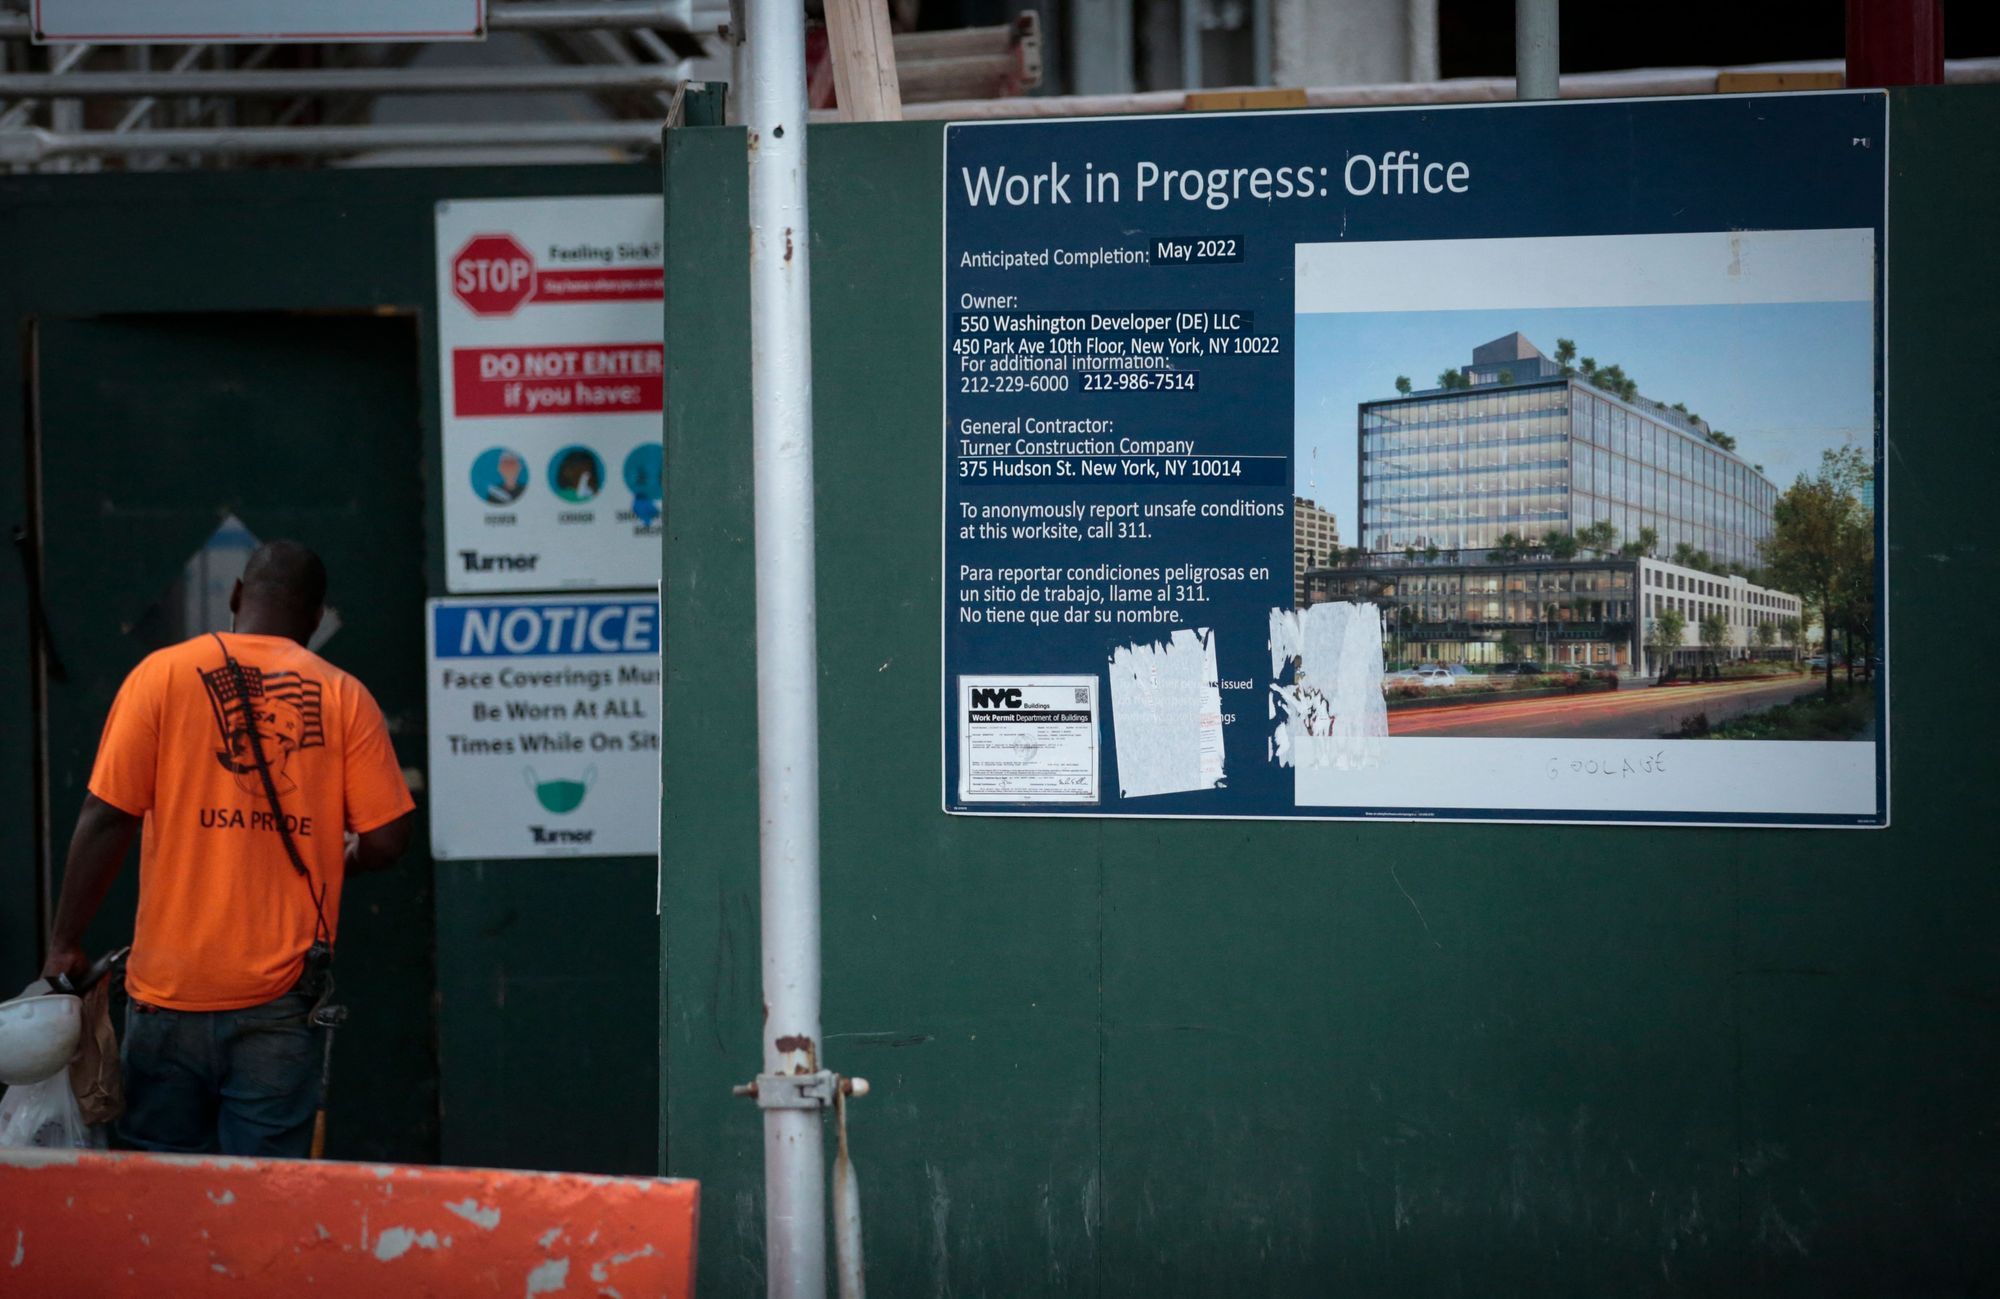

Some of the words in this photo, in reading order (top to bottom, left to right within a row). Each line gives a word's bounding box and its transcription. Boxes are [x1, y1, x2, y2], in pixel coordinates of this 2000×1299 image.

[962, 162, 1071, 206] Work
[1087, 163, 1119, 202] in
[1138, 162, 1327, 210] Progress:
[1345, 151, 1469, 195] Office
[549, 244, 614, 264] Feeling
[961, 249, 1048, 270] Anticipated
[1054, 248, 1148, 268] Completion:
[1159, 243, 1192, 261] May
[1198, 240, 1235, 256] 2022
[456, 258, 530, 293] STOP
[961, 293, 1017, 309] Owner:
[961, 316, 989, 332] 550
[993, 315, 1085, 334] Washington
[1092, 313, 1171, 333] Developer
[1177, 313, 1208, 333] (DE)
[1214, 314, 1240, 329] LLC
[953, 339, 979, 357] 450
[983, 338, 1015, 355] Park
[1016, 339, 1044, 356] Ave
[1050, 337, 1081, 356] 10th
[1087, 338, 1127, 357] Floor,
[1132, 338, 1164, 353] New
[1167, 337, 1203, 358] York,
[1210, 338, 1229, 353] NY
[1235, 337, 1278, 353] 10022
[480, 353, 520, 377] DO
[524, 352, 578, 376] NOT
[582, 351, 662, 375] ENTER
[962, 356, 985, 371] For
[991, 355, 1066, 371] additional
[1073, 354, 1170, 369] information:
[962, 376, 1068, 392] 212-229-6000
[1085, 374, 1194, 390] 212-986-7514
[504, 383, 522, 407] if
[526, 386, 572, 411] you
[576, 381, 641, 404] have:
[961, 417, 1020, 434] General
[1026, 418, 1112, 433] Contractor:
[960, 440, 1011, 456] Turner
[1015, 439, 1115, 455] Construction
[1120, 439, 1195, 456] Company
[960, 461, 987, 476] 375
[994, 460, 1051, 476] Hudson
[1057, 460, 1075, 475] St.
[1082, 460, 1116, 475] New
[1122, 459, 1159, 478] York,
[1166, 460, 1186, 475] NY
[1193, 460, 1241, 476] 10014
[960, 503, 977, 518] To
[982, 501, 1085, 523] anonymously
[1090, 503, 1140, 521] report
[1145, 500, 1195, 516] unsafe
[1201, 500, 1284, 516] conditions
[960, 525, 975, 538] at
[980, 522, 1007, 538] this
[1012, 522, 1082, 541] worksite,
[1088, 522, 1112, 538] call
[1119, 522, 1151, 538] 311.
[459, 551, 539, 572] Turner
[961, 565, 992, 580] Para
[999, 566, 1062, 586] reportar
[1067, 564, 1159, 580] condiciones
[1166, 564, 1244, 586] peligrosas
[1250, 568, 1268, 579] en
[961, 590, 978, 601] un
[984, 586, 1015, 601] sitio
[1021, 585, 1039, 601] de
[1045, 585, 1104, 605] trabajo,
[1110, 585, 1152, 601] llame
[1158, 585, 1170, 601] al
[1176, 586, 1209, 601] 311.
[961, 607, 981, 622] No
[986, 607, 1025, 622] tiene
[1031, 611, 1059, 626] que
[1064, 606, 1090, 622] dar
[1095, 611, 1111, 622] su
[1118, 606, 1183, 622] nombre.
[460, 606, 655, 655] NOTICE
[442, 668, 493, 689] Face
[500, 665, 613, 691] Coverings
[1221, 678, 1253, 689] issued
[972, 688, 1022, 709] NYC
[473, 702, 501, 722] Be
[506, 701, 567, 721] Worn
[572, 701, 598, 719] At
[603, 699, 645, 718] ALL
[1016, 714, 1052, 722] Department
[1061, 714, 1088, 722] Buildings
[448, 734, 515, 755] Times
[519, 732, 584, 751] While
[590, 732, 623, 750] On
[629, 730, 660, 750] Sit
[200, 809, 246, 828] USA
[251, 810, 312, 837] PRDE
[529, 826, 595, 845] Turner
